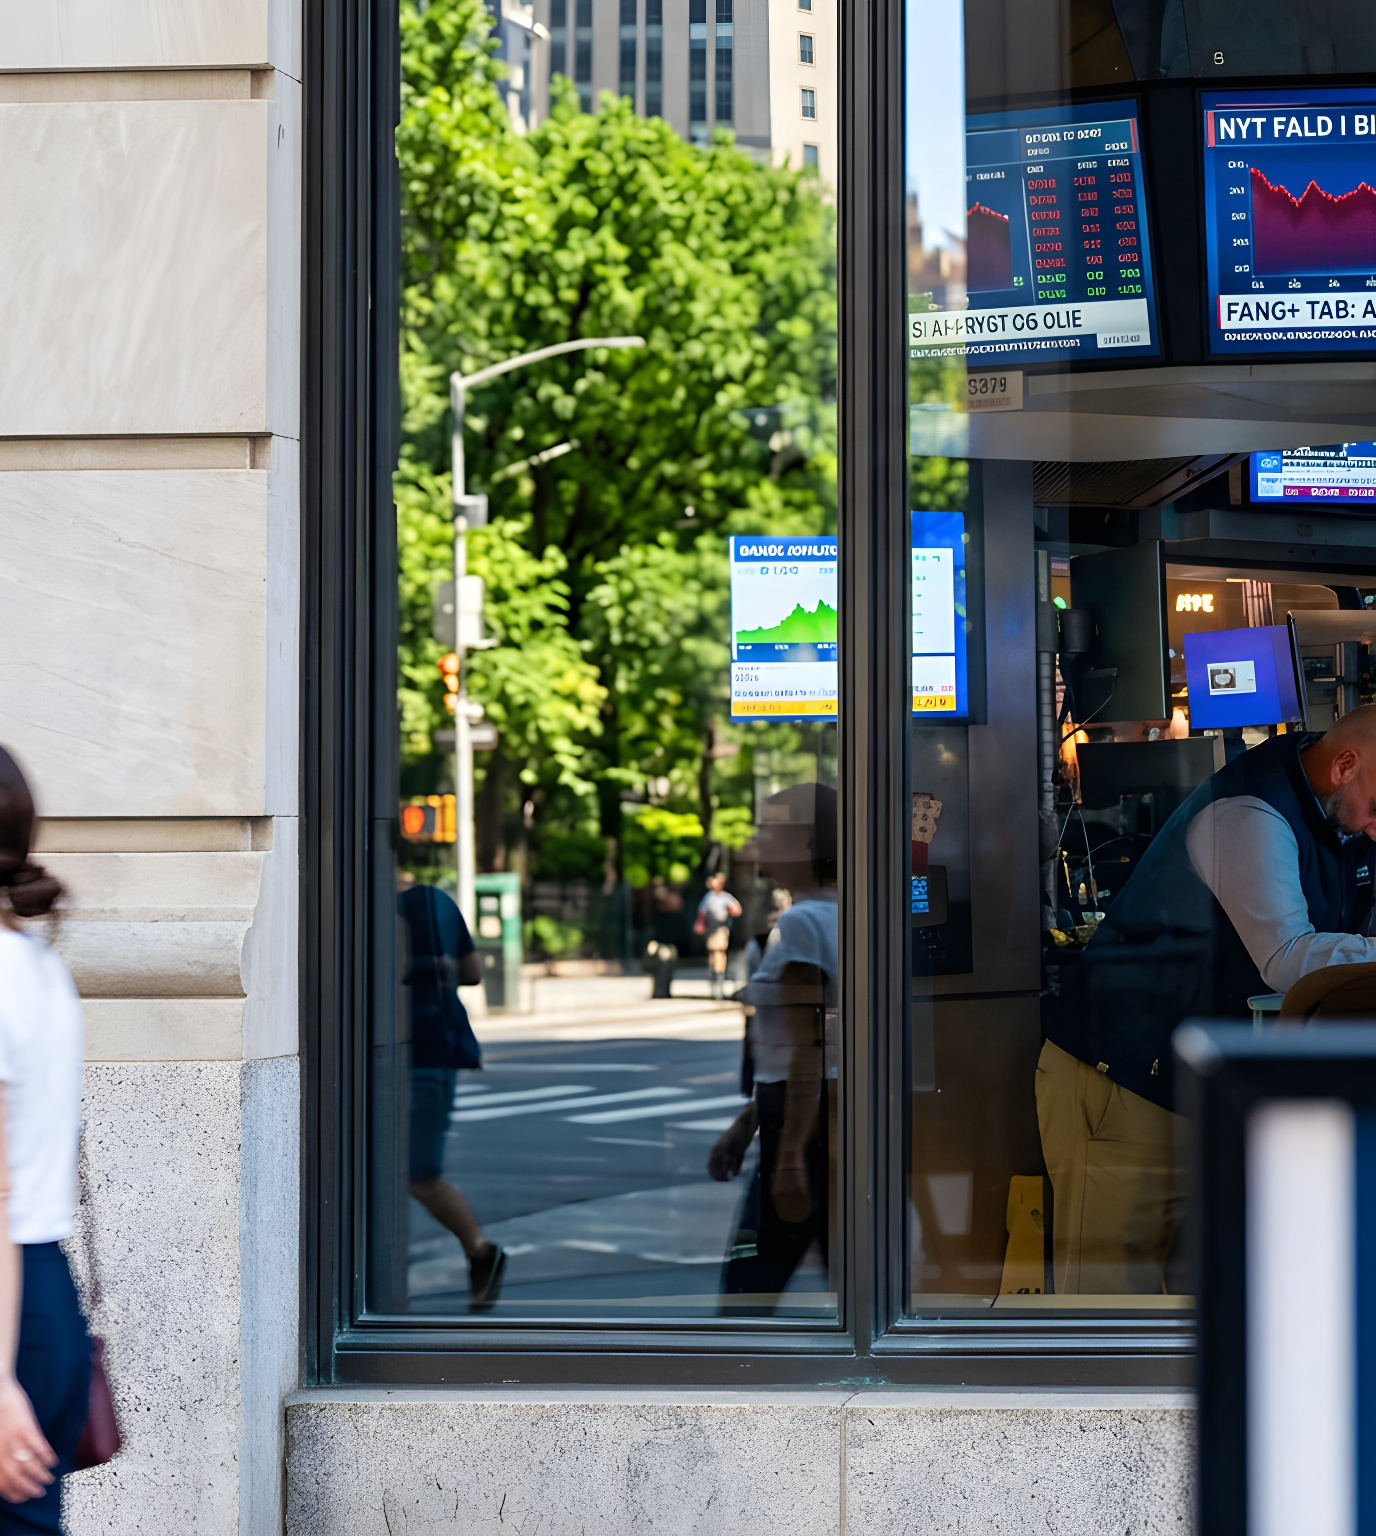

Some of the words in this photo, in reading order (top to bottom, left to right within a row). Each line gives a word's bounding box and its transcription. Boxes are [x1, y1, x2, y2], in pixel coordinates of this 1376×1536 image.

[1219, 117, 1267, 140] NYT
[1273, 115, 1333, 138] FALD
[1340, 115, 1346, 136] I
[1043, 309, 1083, 330] OLIE
[1227, 300, 1300, 322] FANG+
[1305, 299, 1356, 320] TAB:
